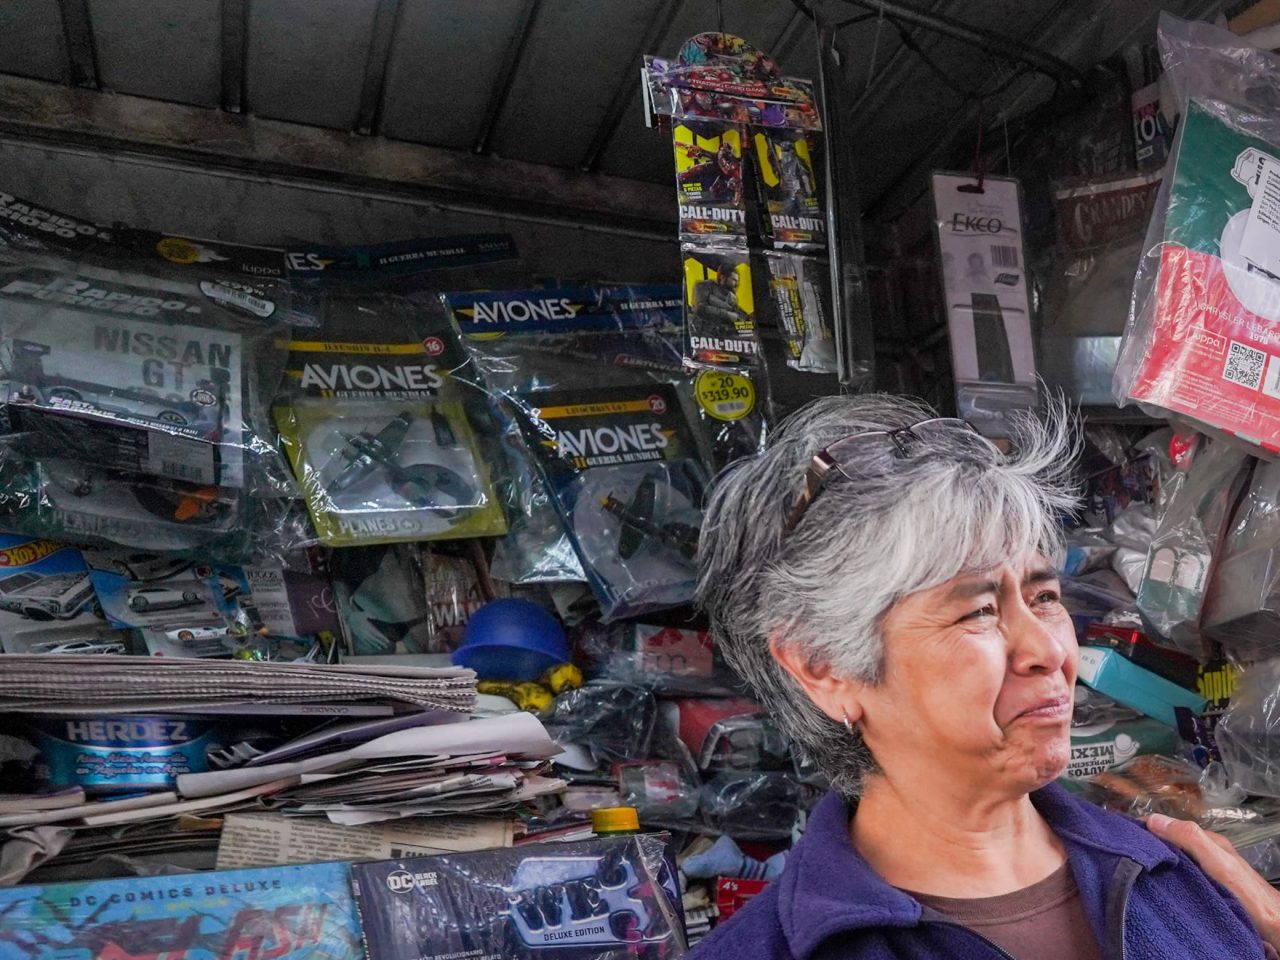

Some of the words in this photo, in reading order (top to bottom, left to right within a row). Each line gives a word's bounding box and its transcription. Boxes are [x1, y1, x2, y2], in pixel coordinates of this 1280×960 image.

[680, 204, 708, 220] CALL
[714, 207, 747, 223] DUTY
[771, 214, 796, 228] CALL
[472, 297, 577, 325] AVIONES
[664, 298, 684, 307] MUN
[94, 326, 232, 368] NISSAN
[426, 341, 440, 353] 16
[690, 335, 721, 351] CALL
[723, 339, 759, 354] DUTY
[300, 363, 445, 390] AVIONES
[718, 377, 735, 388] 20
[702, 385, 749, 402] $319.90
[556, 422, 669, 459] AVIONES
[587, 454, 623, 465] GUERRA
[624, 450, 662, 462] MUNDIAL
[338, 517, 397, 536] PLANES
[66, 721, 191, 741] HERDEZ
[1067, 766, 1105, 778] AUTOS
[388, 875, 413, 890] DC
[70, 895, 96, 907] DC
[111, 887, 193, 904] COMICS
[206, 880, 282, 896] DELUXE
[544, 931, 573, 942] DELUXE
[575, 926, 606, 937] EDITION
